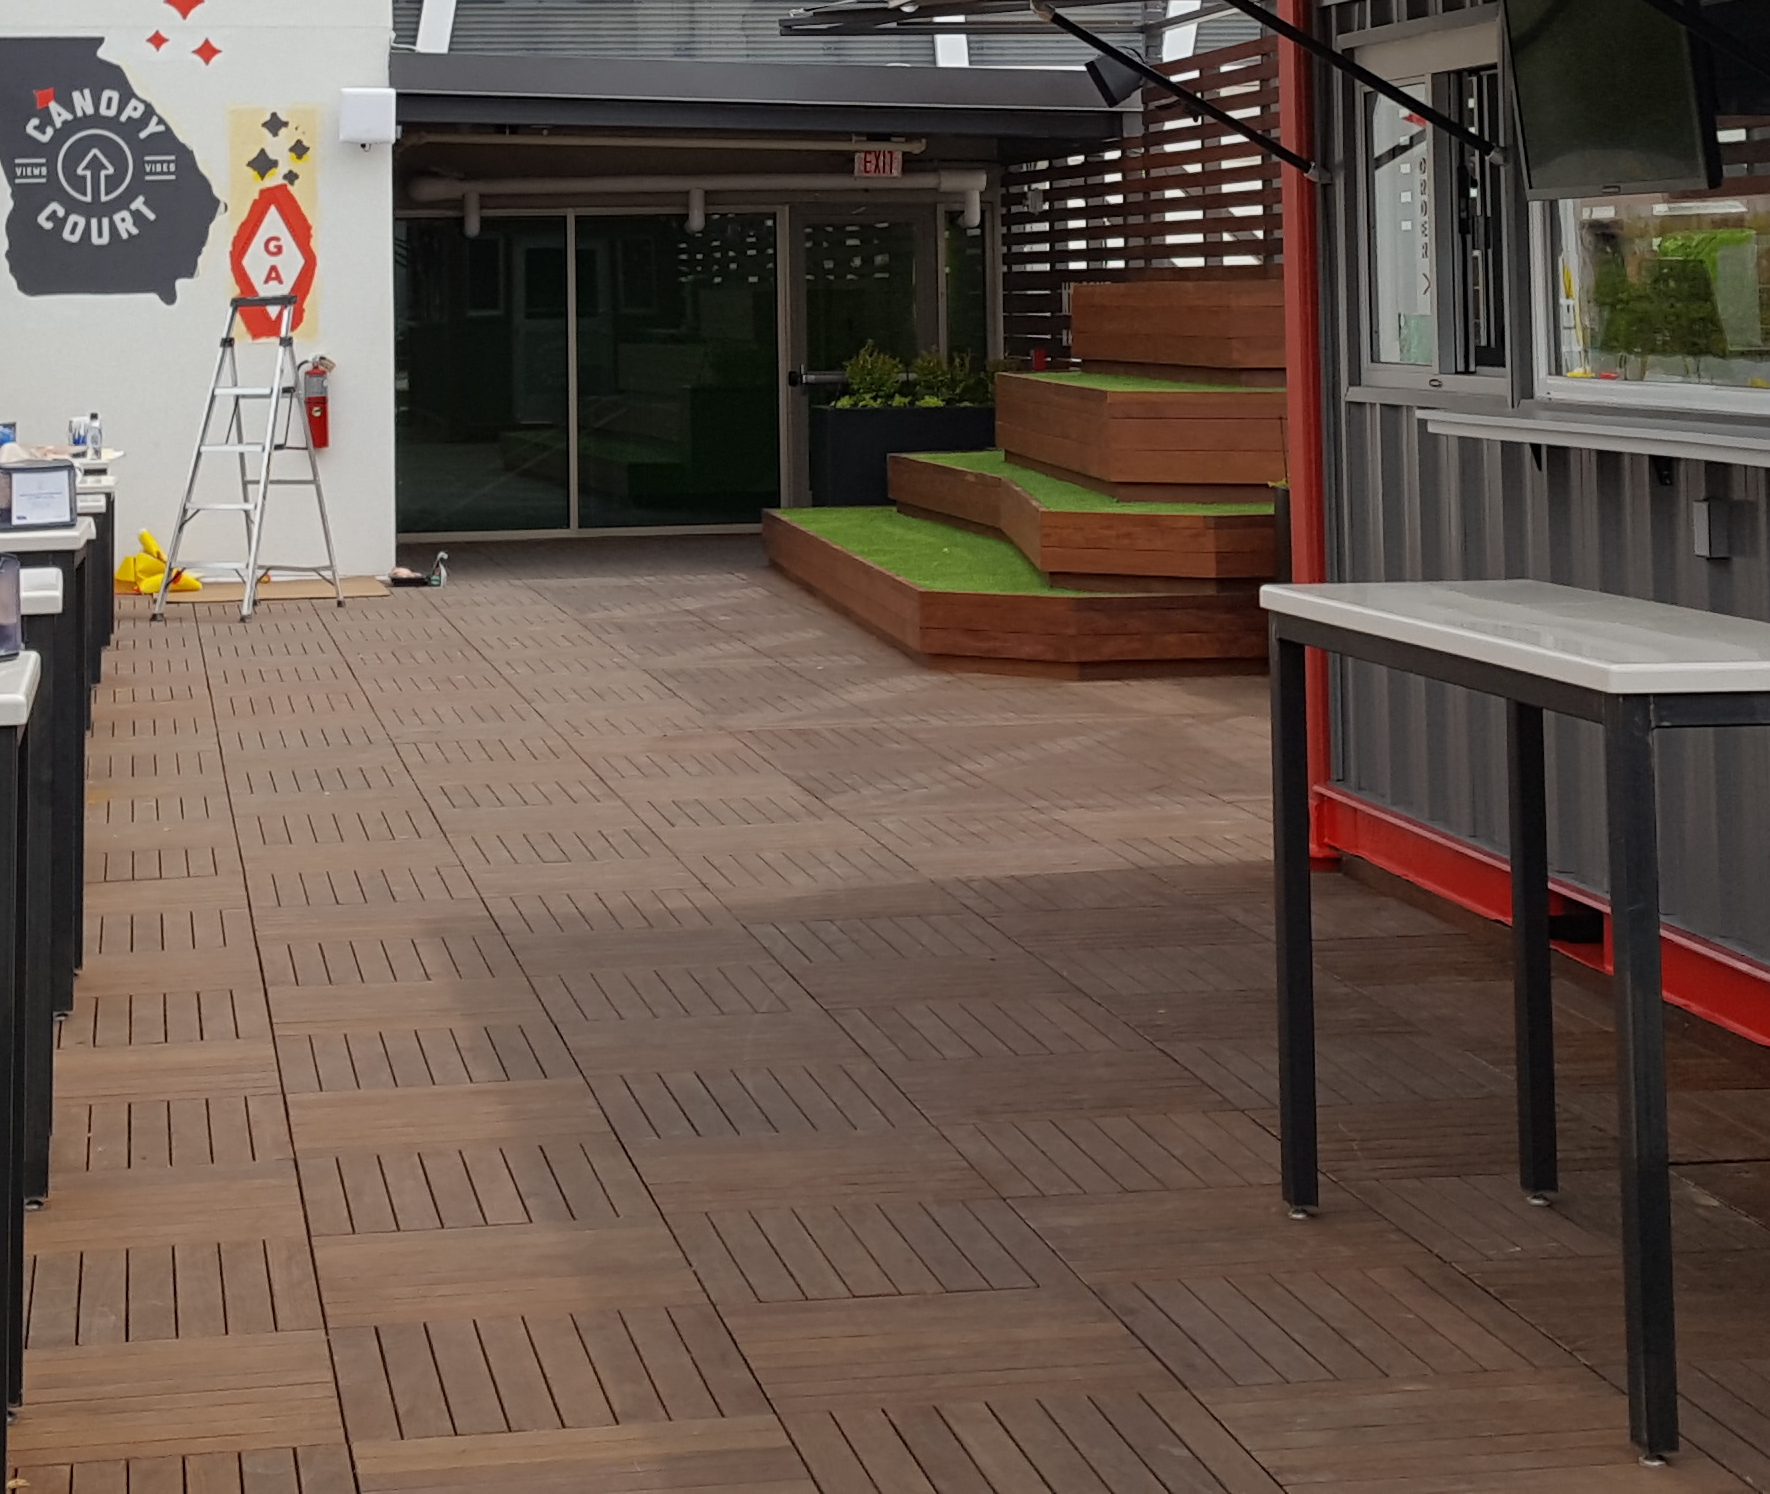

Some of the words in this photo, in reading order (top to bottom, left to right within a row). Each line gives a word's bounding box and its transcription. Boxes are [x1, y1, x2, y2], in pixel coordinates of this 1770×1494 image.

[25, 87, 166, 144] CANOPY
[14, 166, 47, 177] VIEWS
[144, 162, 176, 173] VIBES
[863, 150, 894, 174] EXIT
[36, 194, 157, 246] COURT
